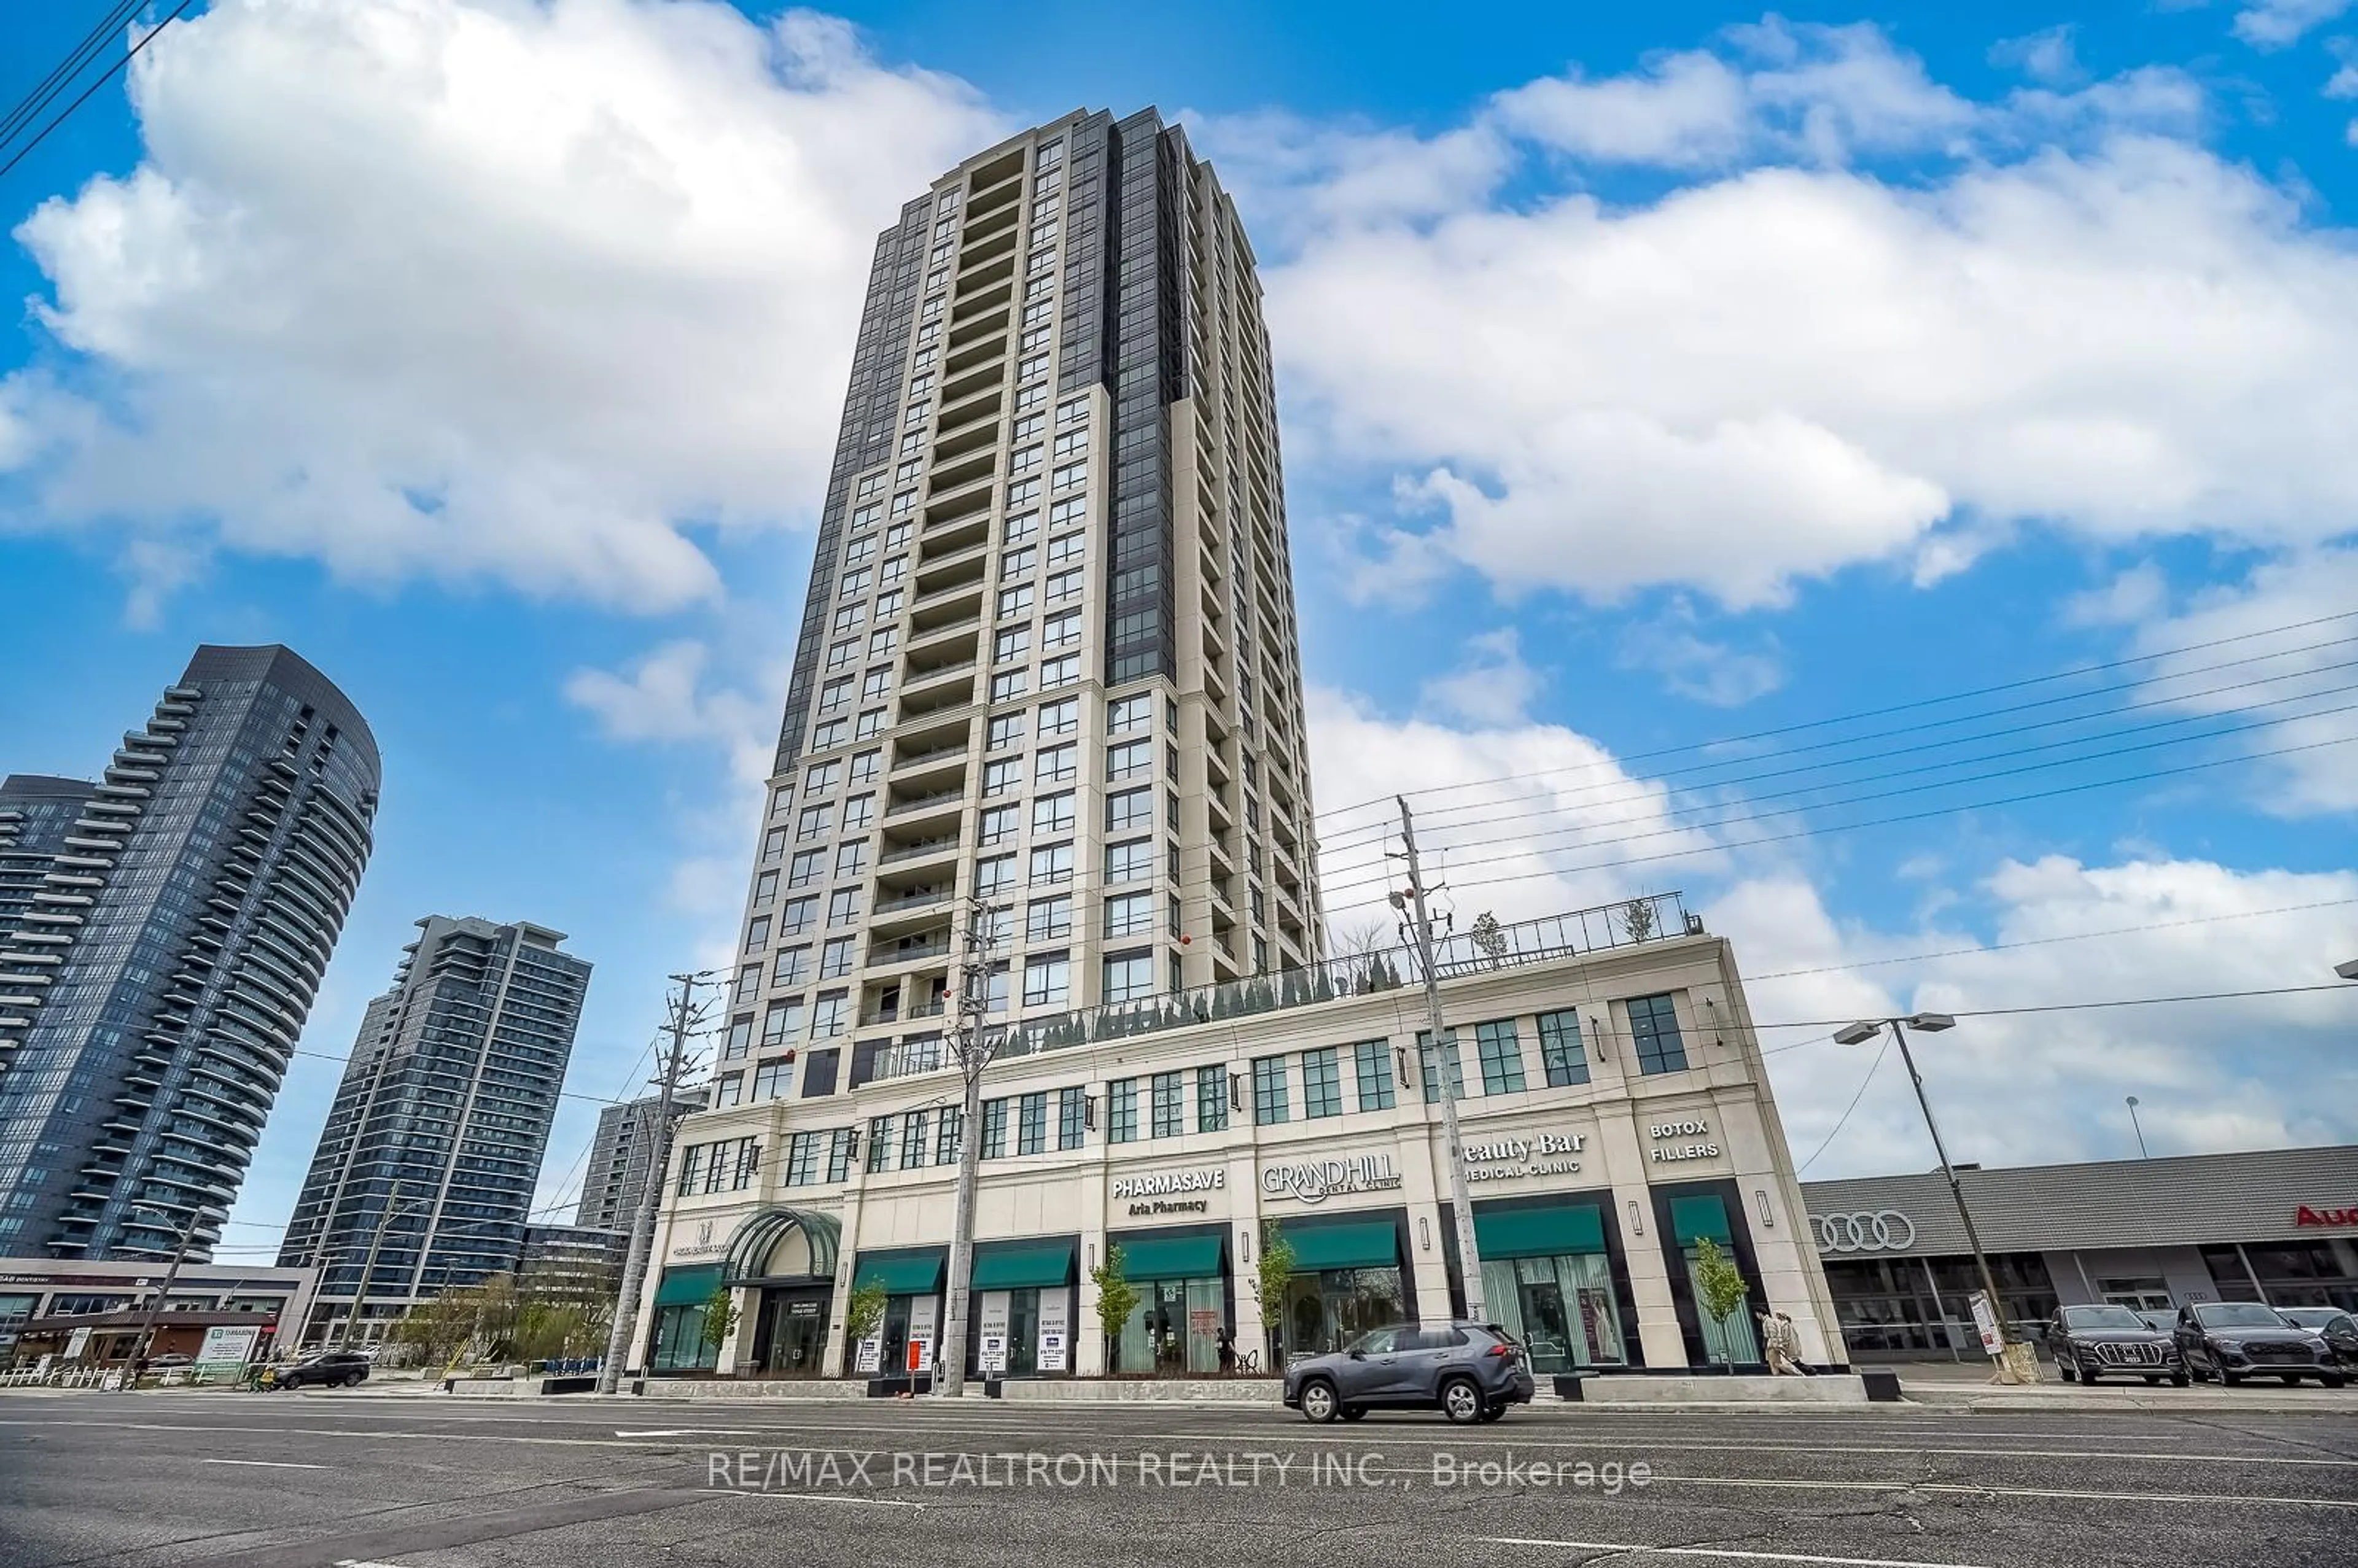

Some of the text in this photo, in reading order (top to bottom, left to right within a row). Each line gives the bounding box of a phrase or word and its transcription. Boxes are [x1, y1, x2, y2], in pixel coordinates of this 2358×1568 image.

[1651, 1120, 1708, 1138] BOTOX
[1462, 1134, 1586, 1162] eauty Bar
[1651, 1143, 1719, 1162] FILLERS
[1529, 1160, 1579, 1175] CLINIC
[1113, 1169, 1224, 1198] PHARMASAVE
[1319, 1180, 1402, 1194] DENTAL CLINIC
[1129, 1200, 1207, 1216] Aria Pharmacy
